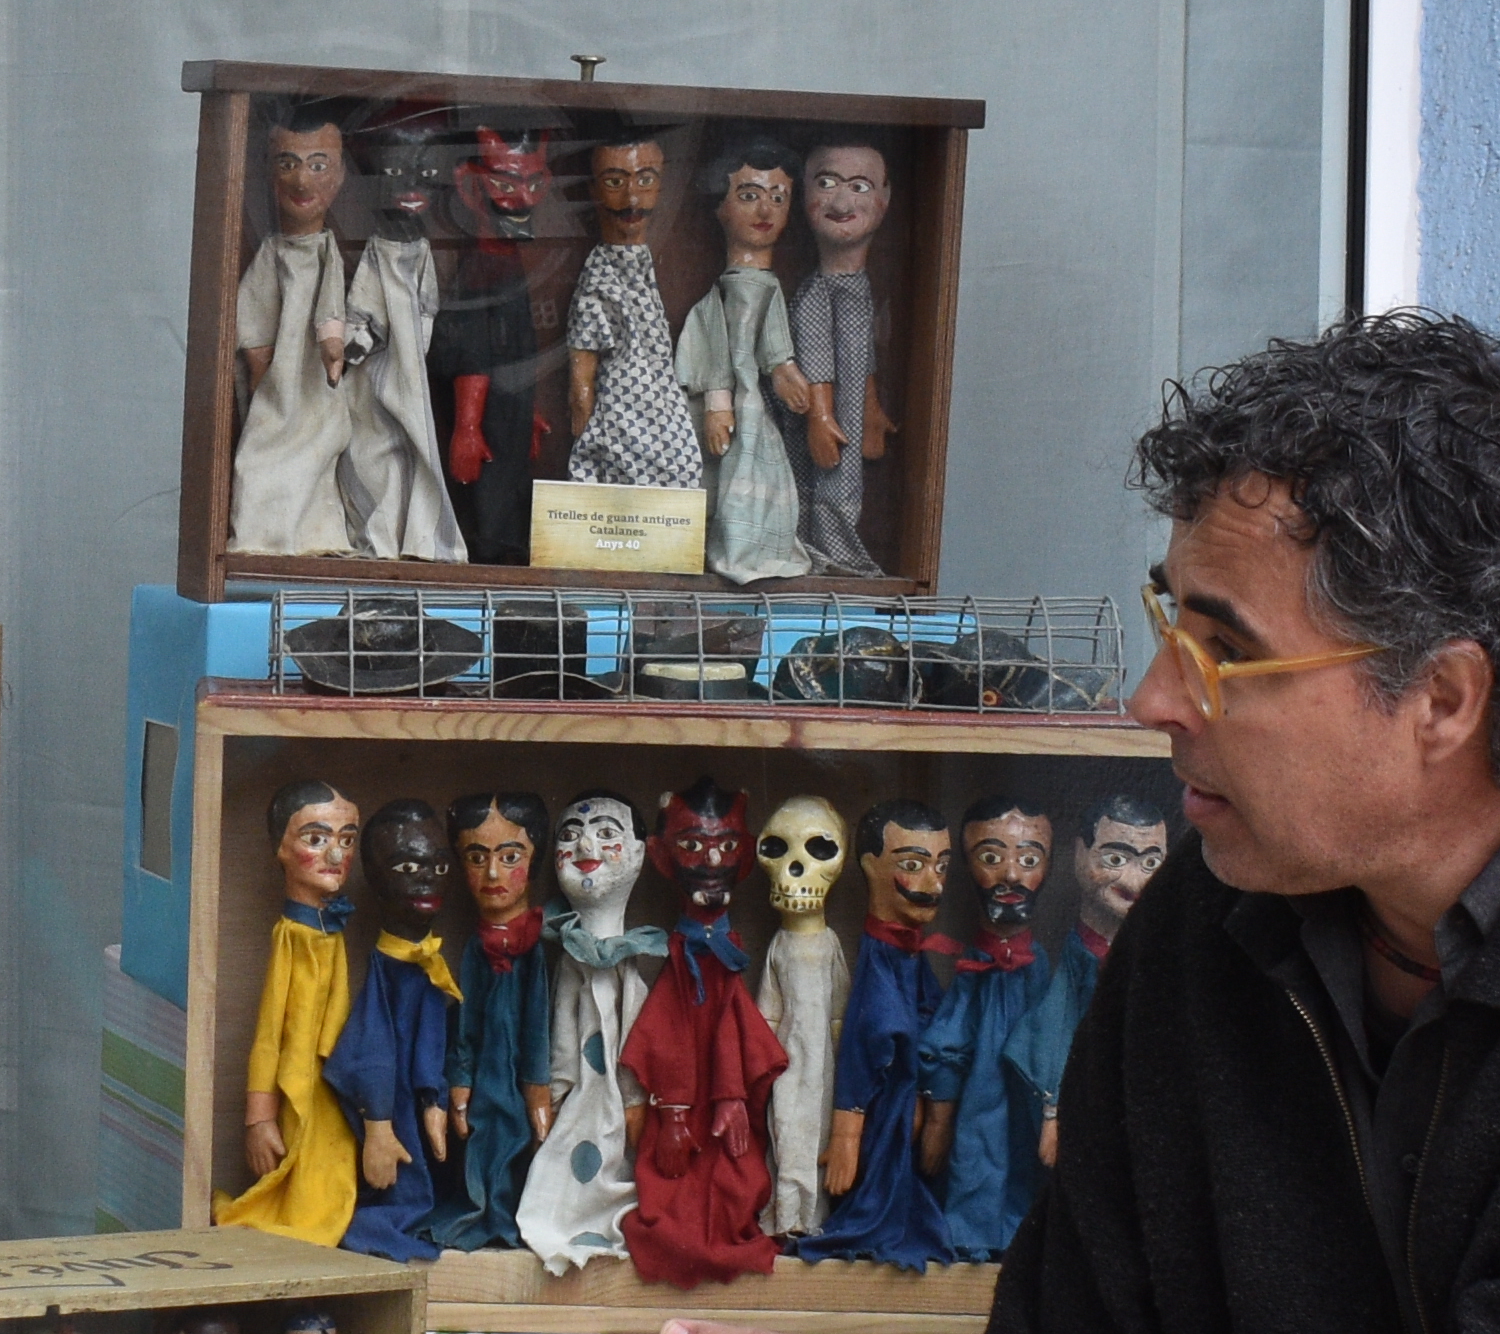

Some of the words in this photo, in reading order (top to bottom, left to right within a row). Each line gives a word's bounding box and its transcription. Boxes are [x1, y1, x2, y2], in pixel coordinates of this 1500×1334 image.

[547, 509, 588, 522] Titelles
[590, 511, 604, 522] de
[606, 513, 639, 525] guant
[642, 513, 691, 527] antigues
[589, 525, 647, 537] Catalanes.
[595, 538, 624, 551] Anys
[626, 539, 640, 550] 40
